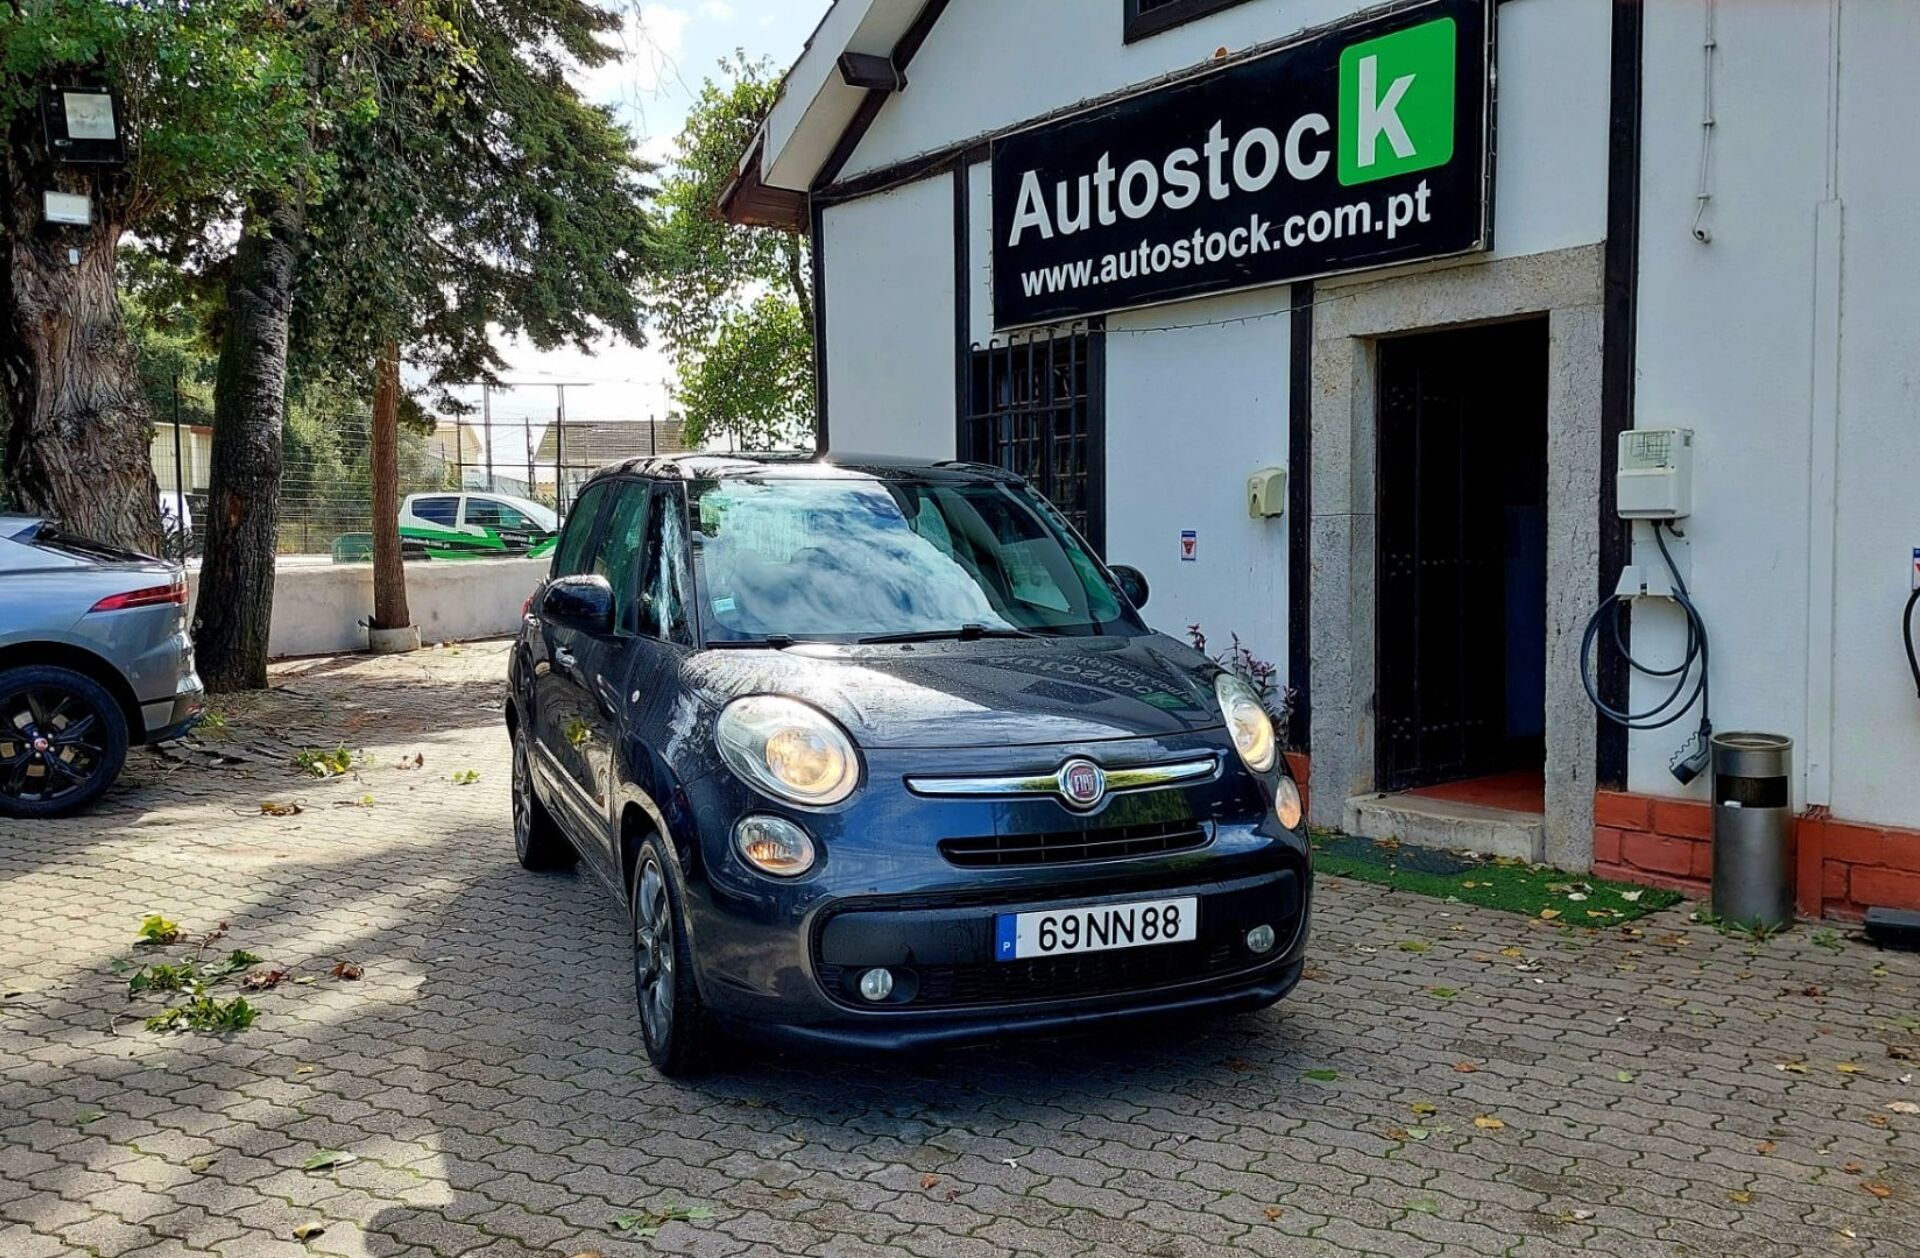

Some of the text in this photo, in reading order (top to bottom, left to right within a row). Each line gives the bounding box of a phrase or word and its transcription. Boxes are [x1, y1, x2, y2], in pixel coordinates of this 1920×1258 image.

[1008, 54, 1416, 246] Autostock
[1021, 179, 1431, 297] www.autostock.com.pt
[1003, 941, 1011, 952] P
